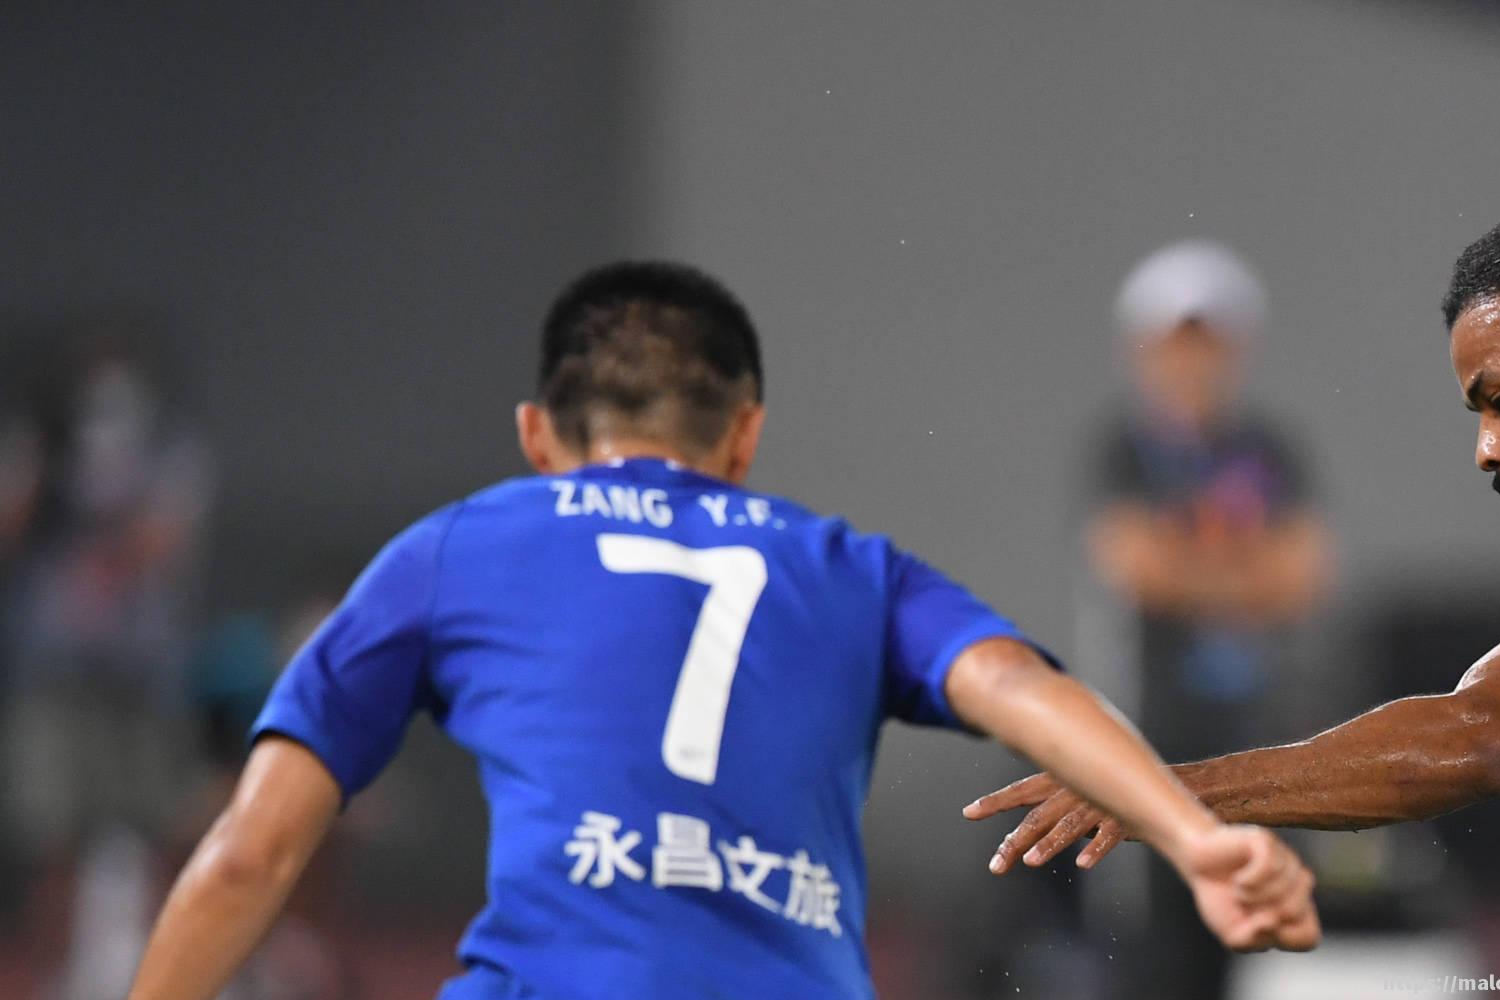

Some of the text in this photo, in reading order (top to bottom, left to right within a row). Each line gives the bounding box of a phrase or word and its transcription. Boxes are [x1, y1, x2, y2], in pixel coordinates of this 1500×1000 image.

[551, 479, 674, 529] ZANG
[596, 533, 767, 785] 7
[564, 811, 843, 937] 永昌文旅
